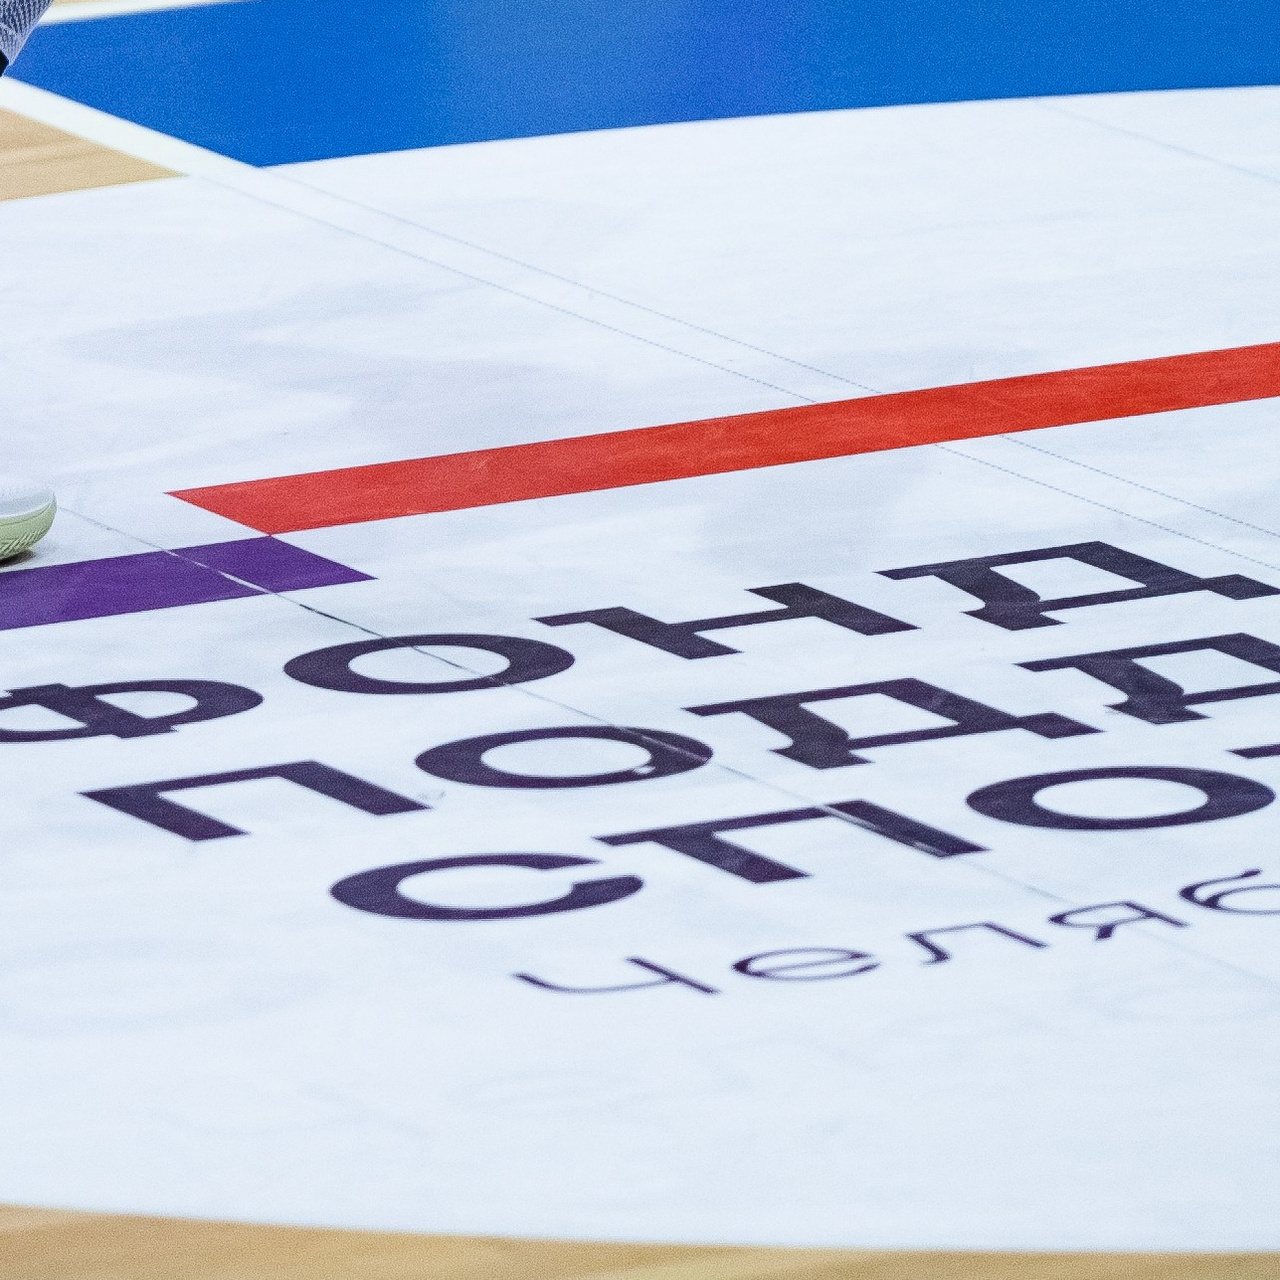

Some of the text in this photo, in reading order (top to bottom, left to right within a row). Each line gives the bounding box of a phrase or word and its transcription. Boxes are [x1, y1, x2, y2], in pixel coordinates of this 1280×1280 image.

[78, 632, 1280, 841] ПОДД
[329, 743, 1280, 922] СПО
[511, 868, 1280, 995] Челяб
